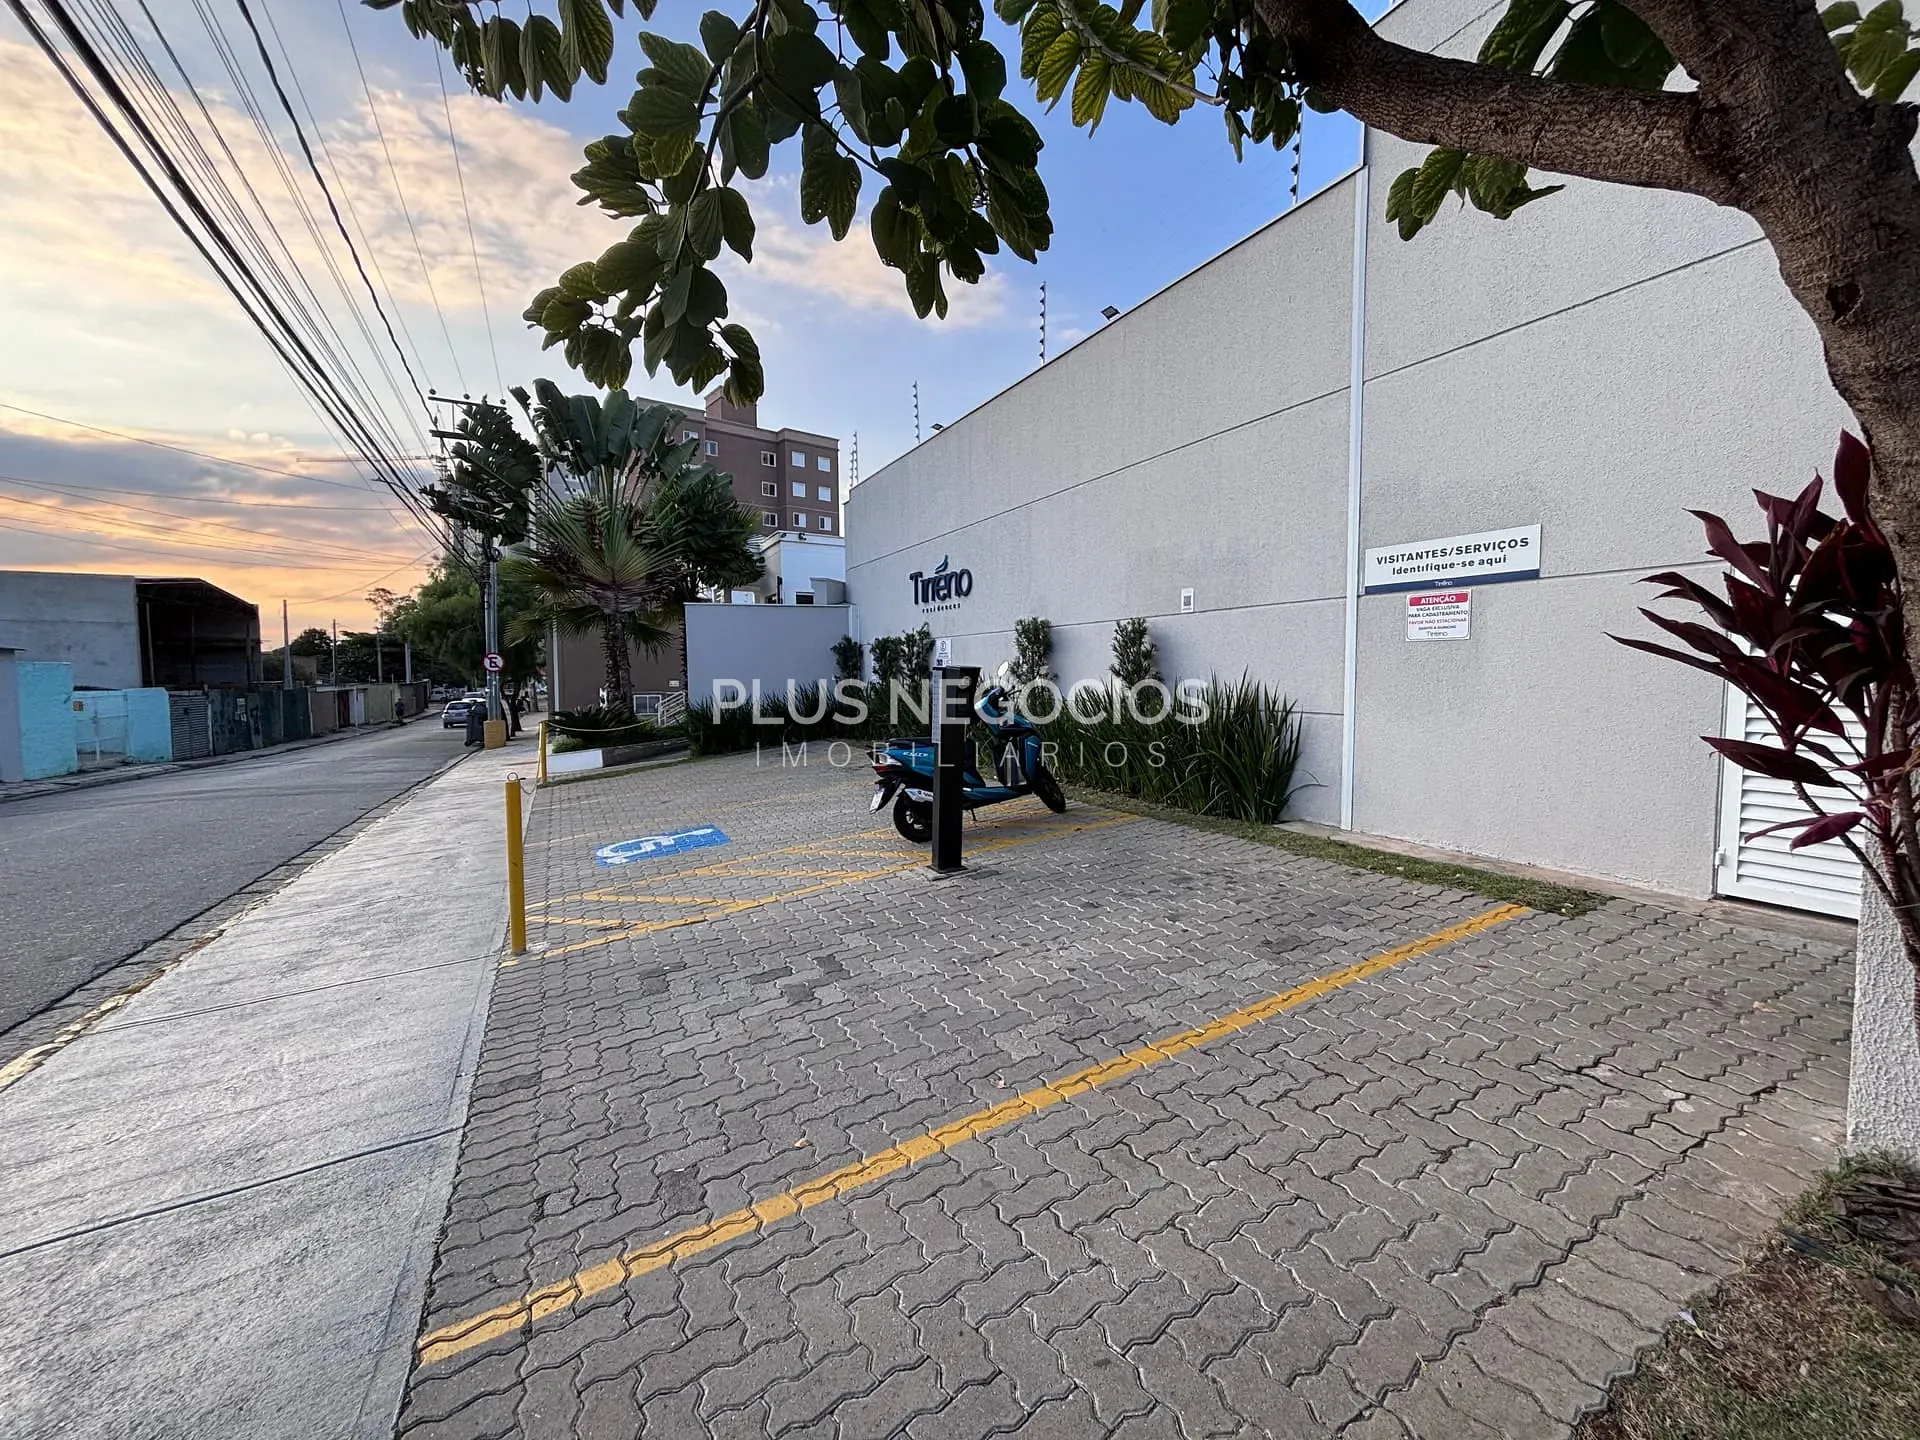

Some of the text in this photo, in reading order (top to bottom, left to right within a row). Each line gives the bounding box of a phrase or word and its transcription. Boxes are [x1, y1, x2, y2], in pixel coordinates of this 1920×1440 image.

[1376, 537, 1529, 565] VISITANTES/SERVIÇOS
[1392, 554, 1507, 575] Identifique-se aqui
[1420, 594, 1456, 605] ATENÇÃO
